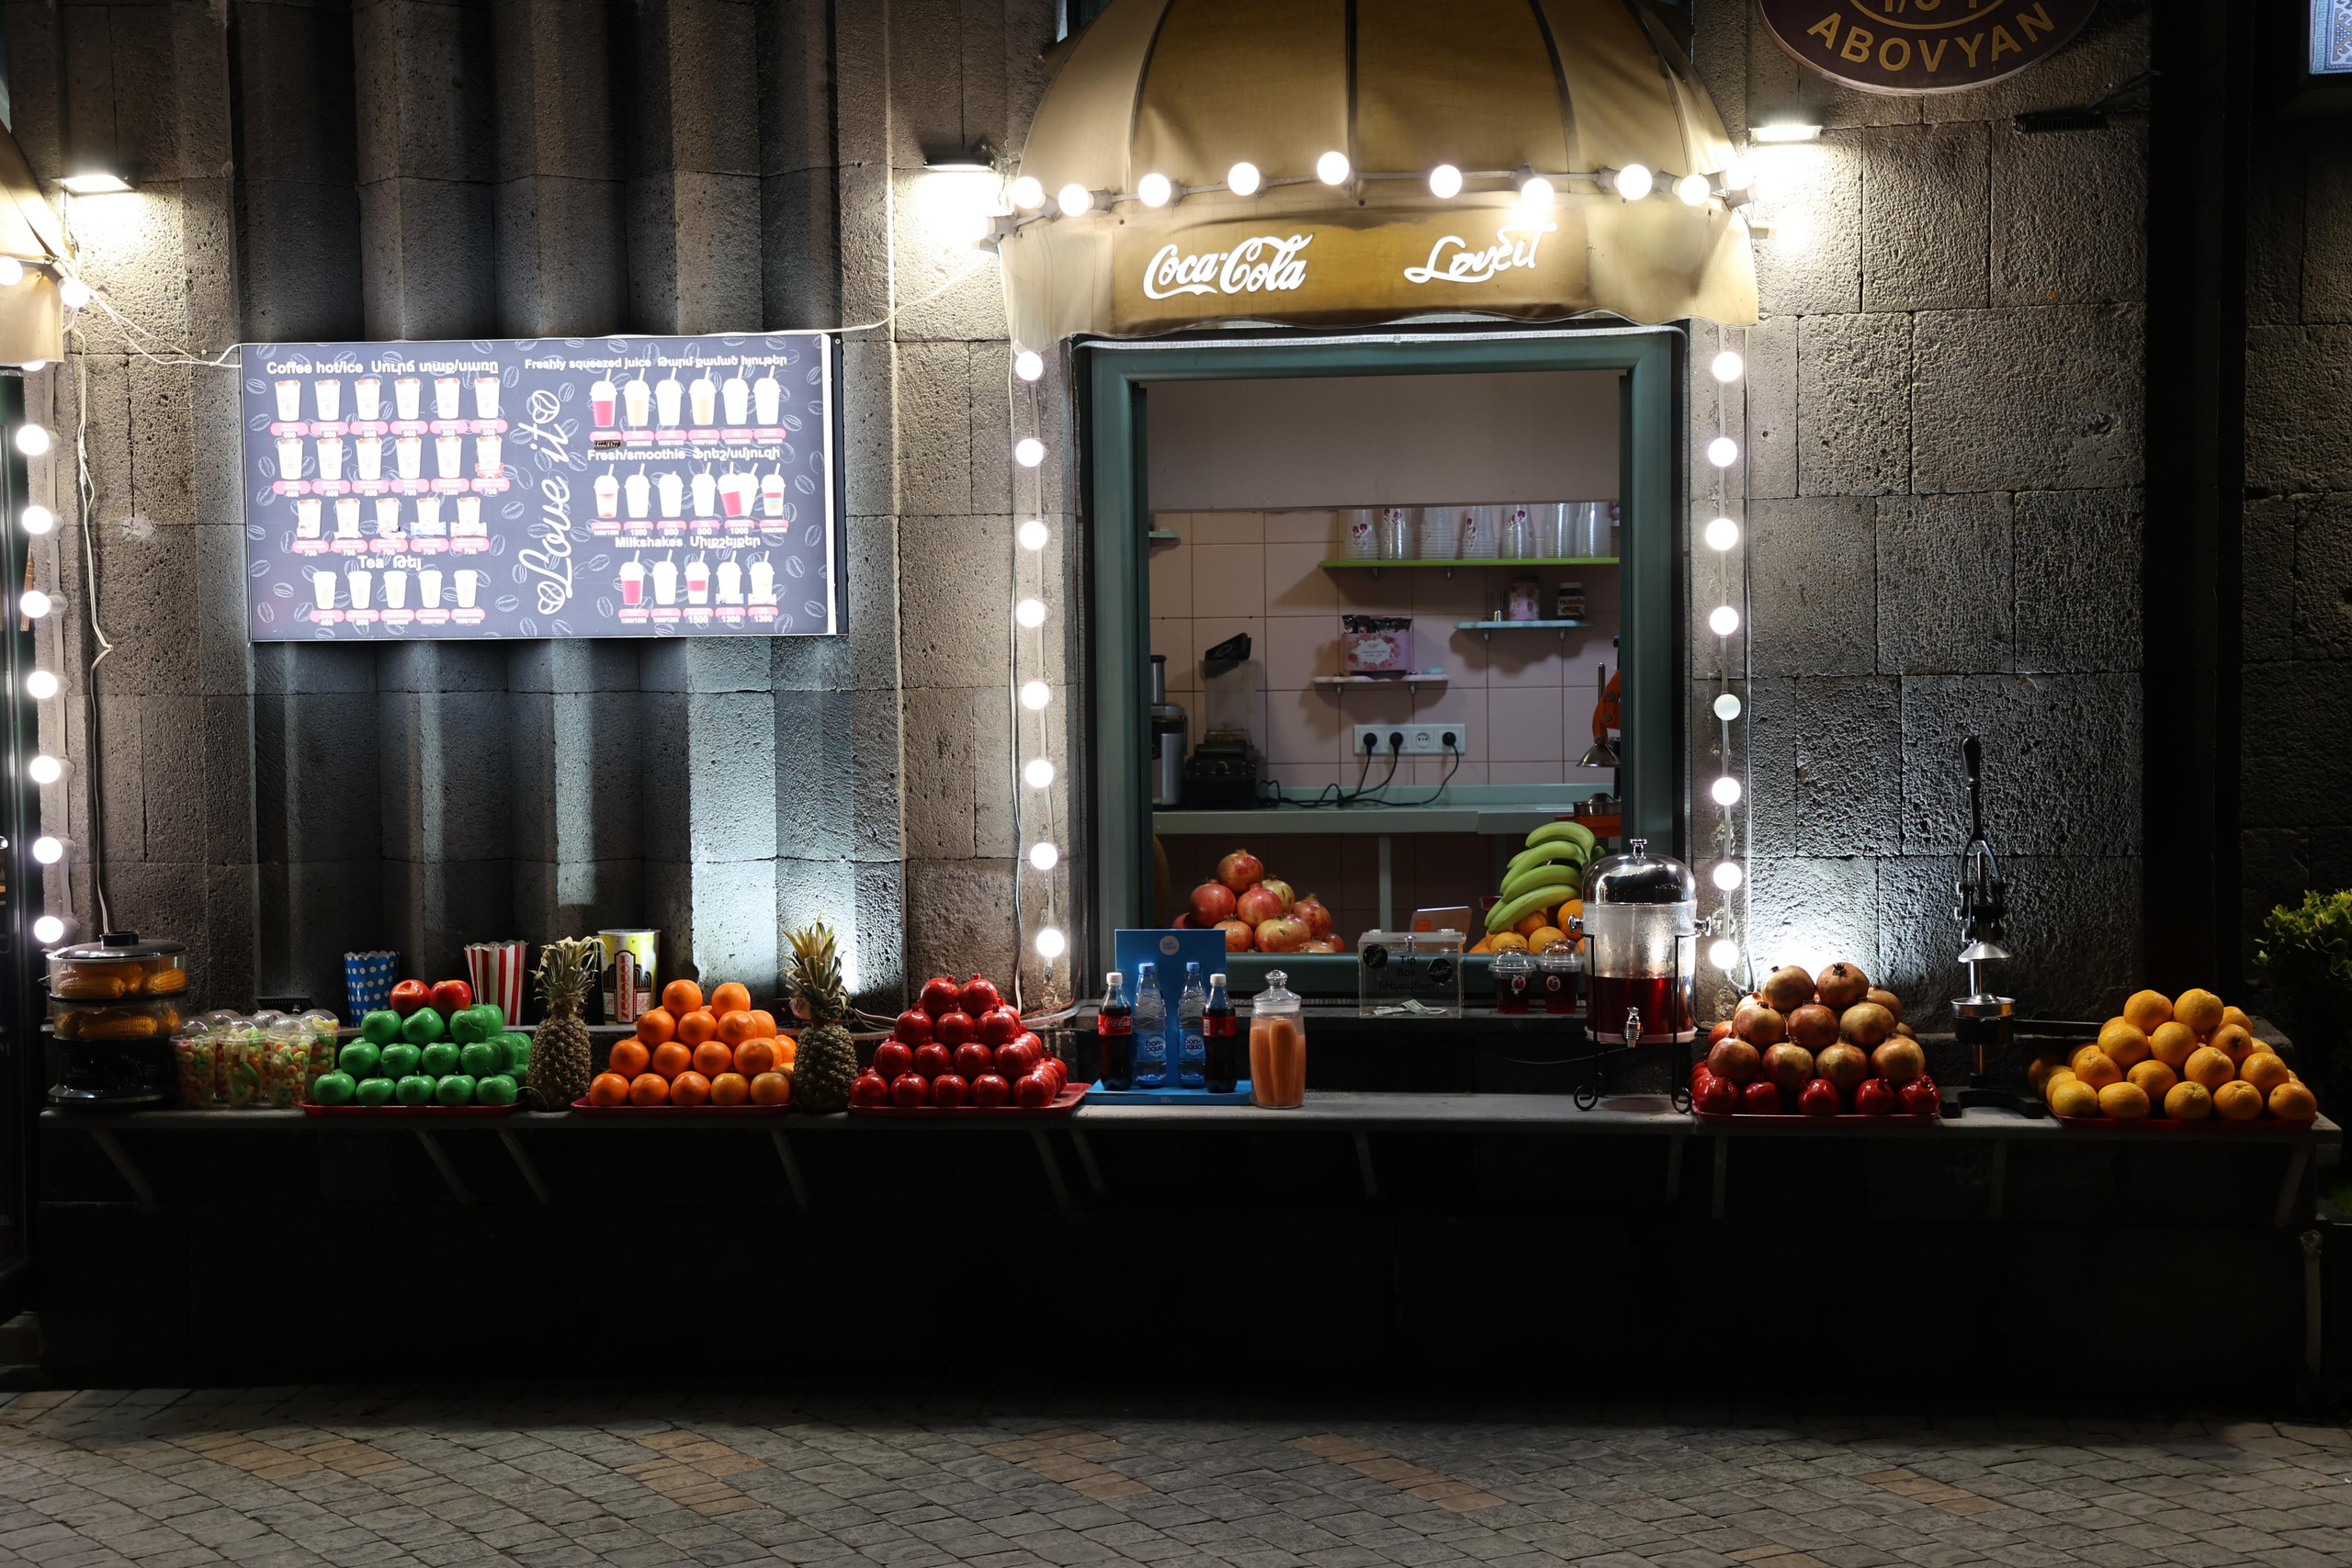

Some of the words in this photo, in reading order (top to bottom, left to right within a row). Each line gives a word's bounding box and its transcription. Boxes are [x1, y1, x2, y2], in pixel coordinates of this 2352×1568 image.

[1806, 2, 2056, 72] ABOVYAN
[1143, 233, 1314, 299] Coca-Cola
[266, 361, 312, 375] Coffee
[316, 361, 364, 374] hot/ice
[525, 359, 567, 370] Freshly
[569, 358, 622, 370] squeezed
[624, 357, 651, 369] juice
[587, 449, 685, 461] Fresh/smoothie
[518, 476, 573, 599] Love
[615, 537, 684, 548] Milkshakes
[357, 556, 385, 569] Tea
[688, 615, 708, 624] 1500
[753, 615, 773, 623] 1300
[1399, 955, 1417, 965] Tip
[1396, 968, 1416, 977] Box
[1104, 1016, 1131, 1028] Coca-Cola
